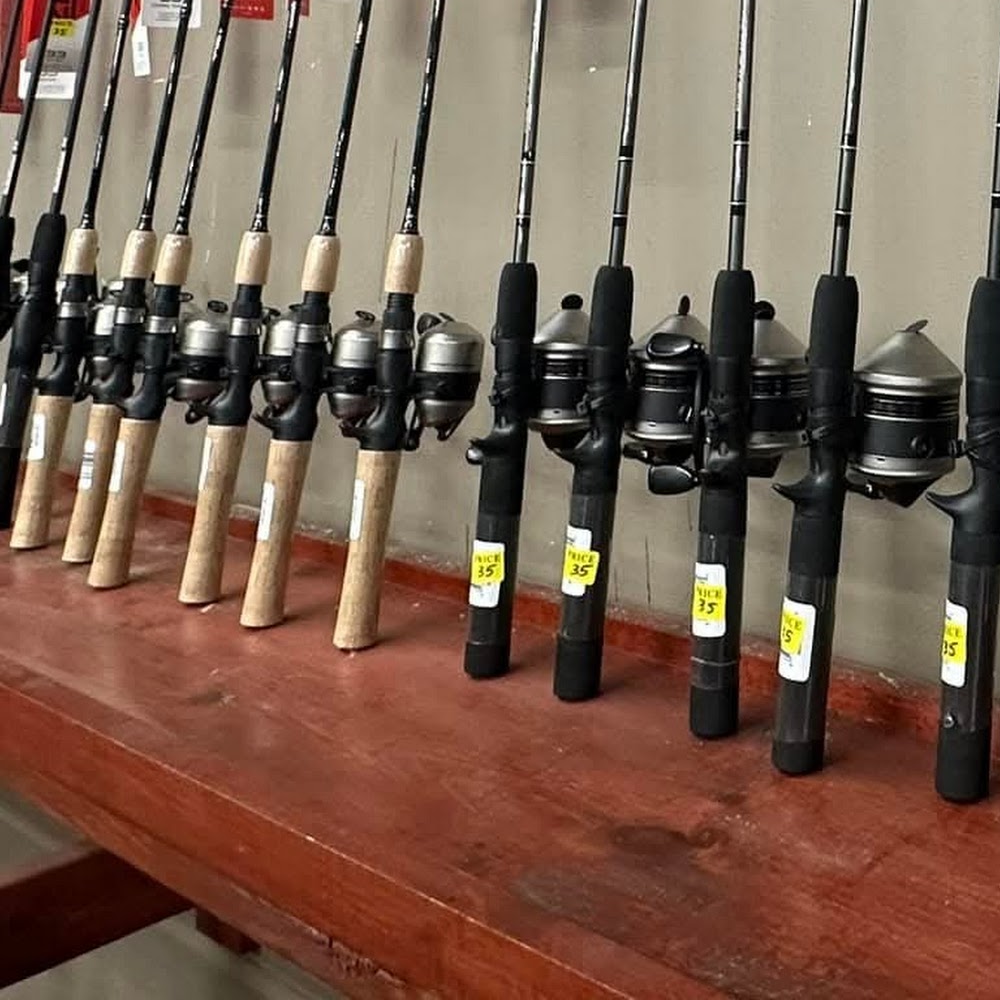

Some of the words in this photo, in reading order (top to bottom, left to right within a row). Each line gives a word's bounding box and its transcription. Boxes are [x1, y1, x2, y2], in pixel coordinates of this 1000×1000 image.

[478, 563, 498, 578] 35
[570, 563, 594, 577] 35
[698, 597, 719, 615] 35
